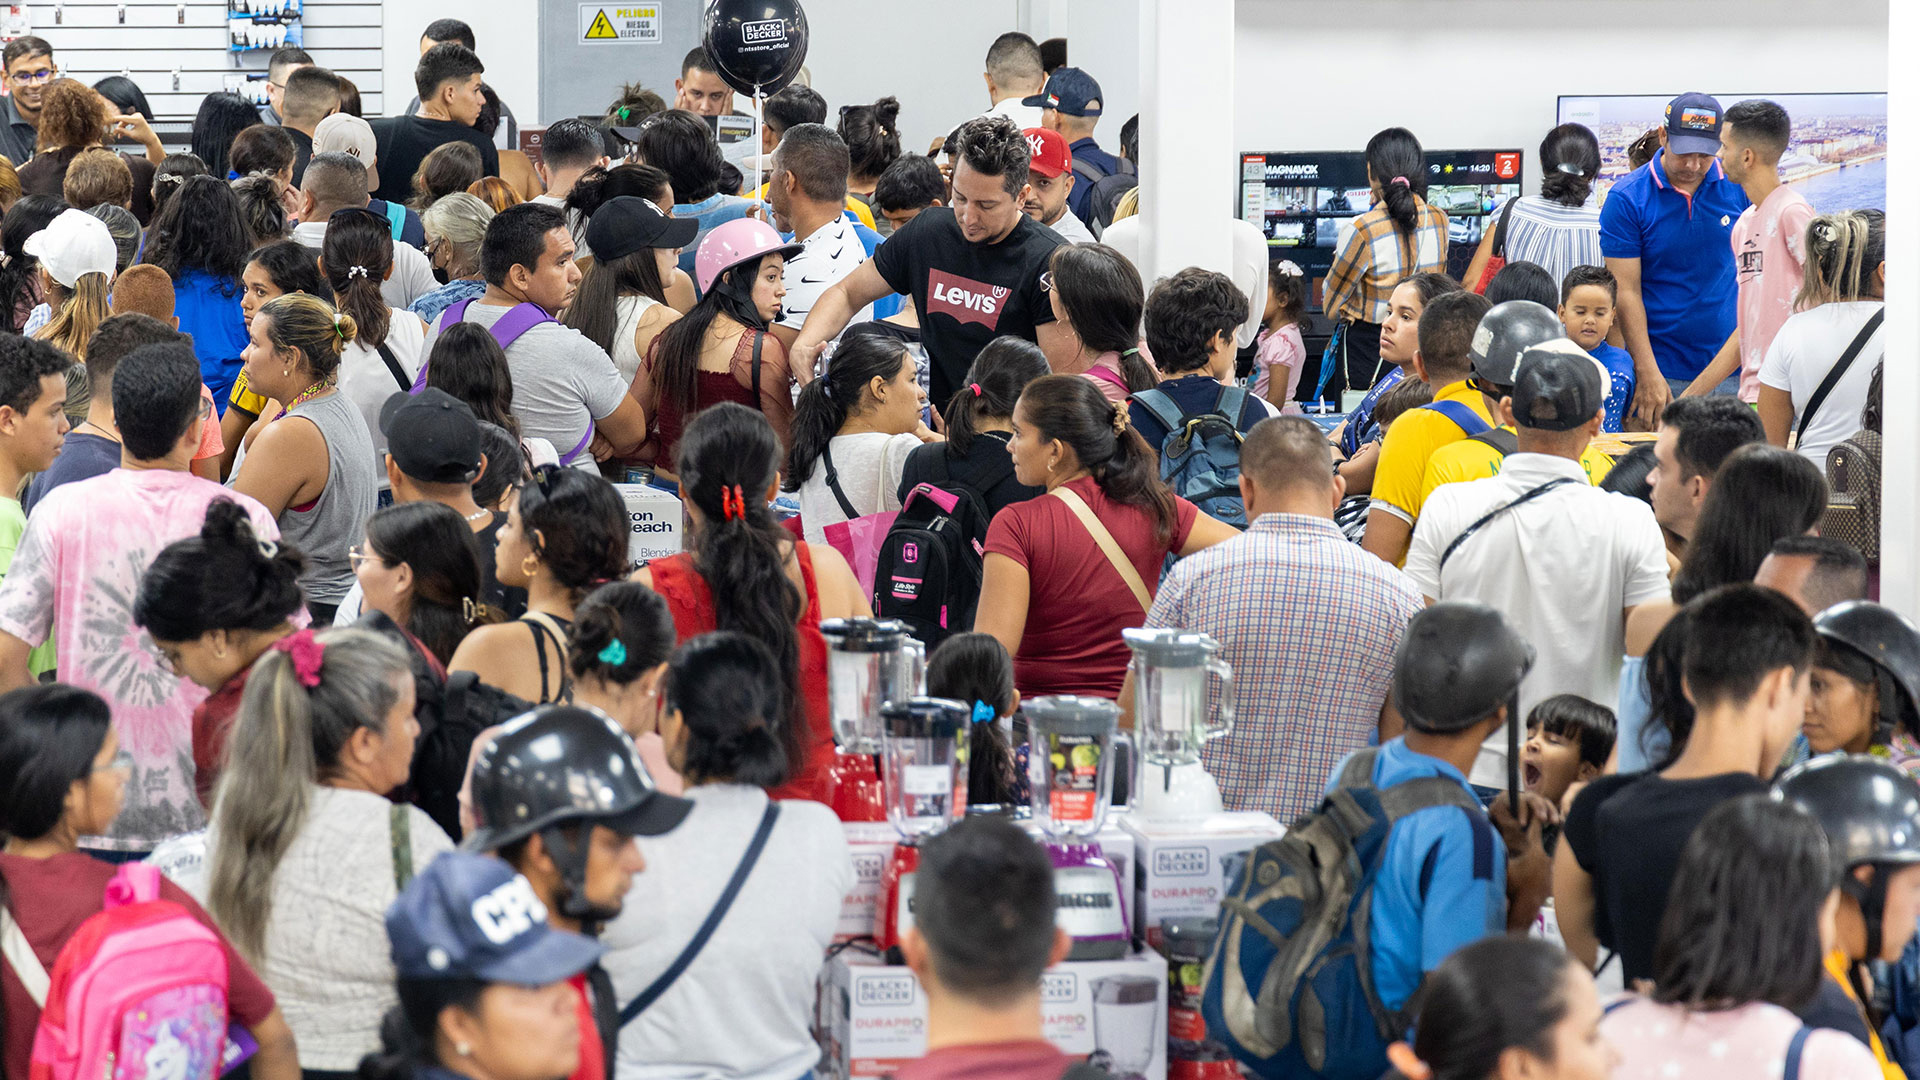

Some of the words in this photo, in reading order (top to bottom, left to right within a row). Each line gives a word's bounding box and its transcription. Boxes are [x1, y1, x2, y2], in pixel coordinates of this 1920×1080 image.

[616, 8, 656, 18] PELIGRO
[626, 20, 650, 29] RIESGO
[746, 23, 781, 33] BLACK+
[746, 30, 782, 40] DECKER
[1470, 164, 1491, 172] 14:20
[632, 521, 673, 532] each
[1158, 862, 1204, 872] DECKER
[1151, 886, 1217, 899] DURAPRO
[860, 991, 910, 1001] DECKER
